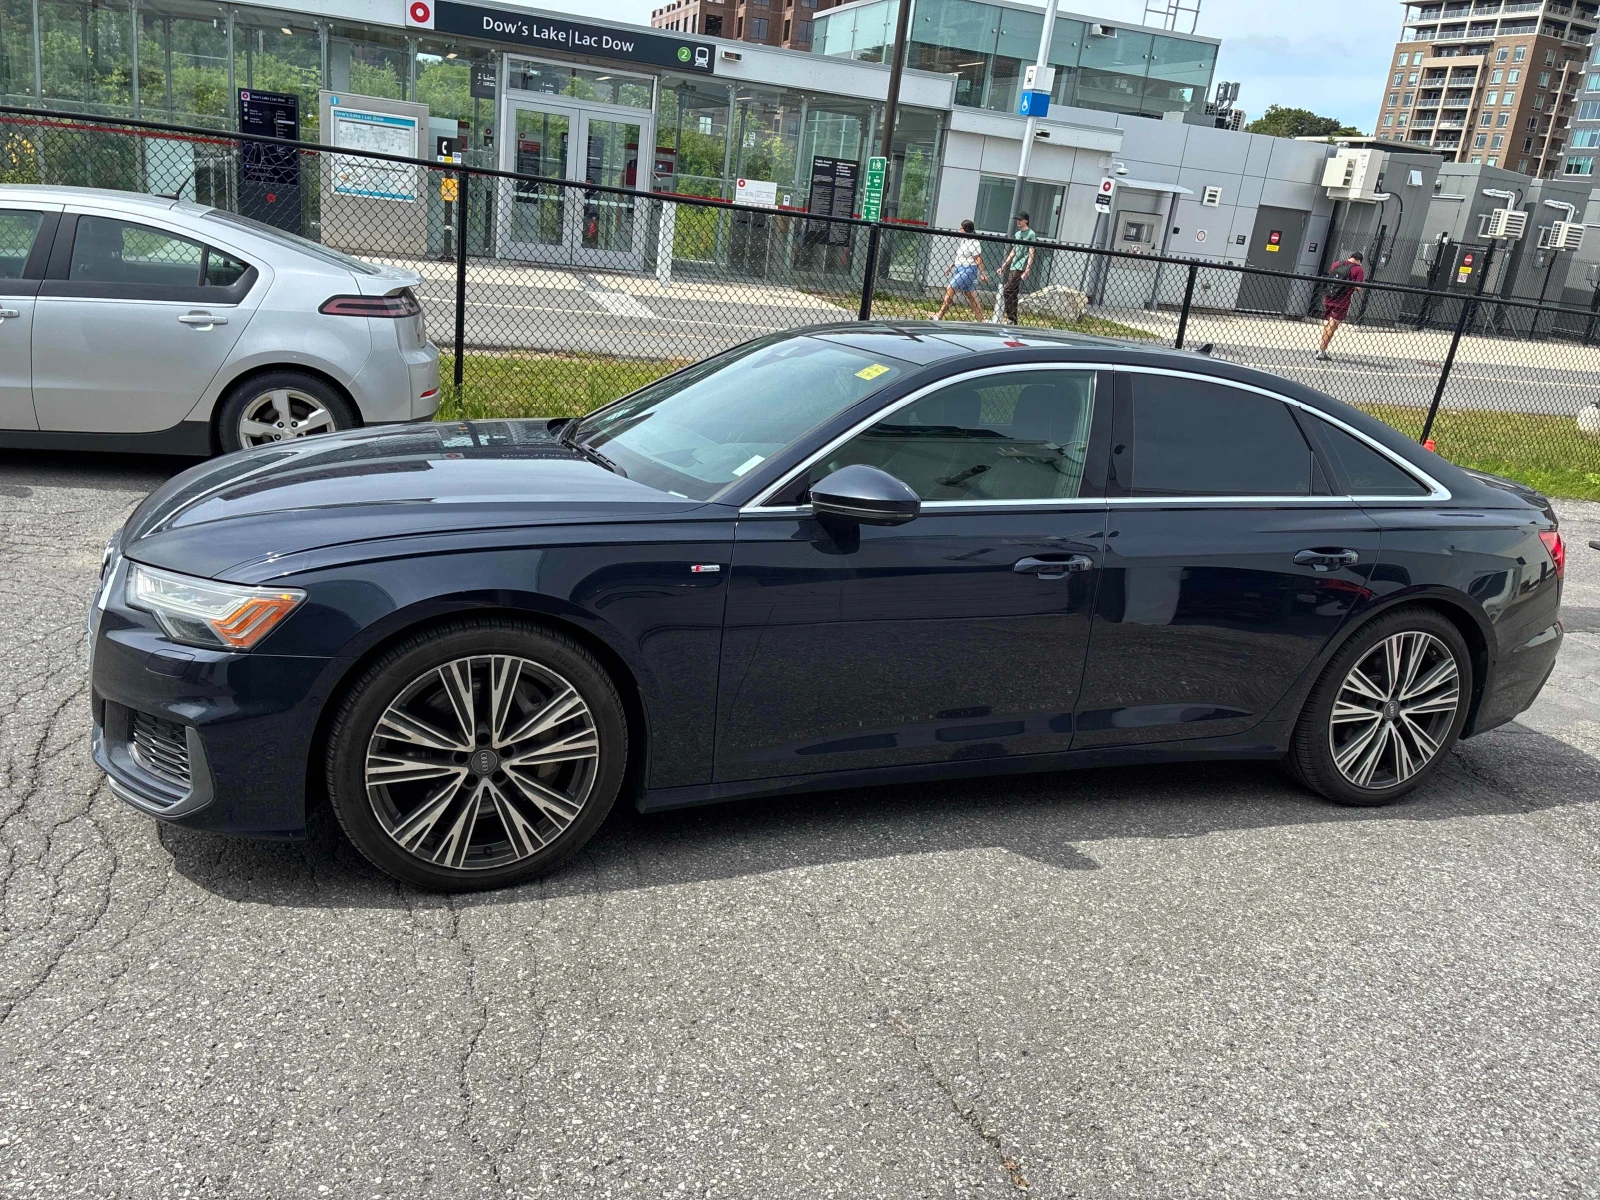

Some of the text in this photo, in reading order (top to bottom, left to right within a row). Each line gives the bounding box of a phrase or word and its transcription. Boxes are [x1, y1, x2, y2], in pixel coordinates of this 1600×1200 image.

[483, 16, 635, 53] Dow's Lake Lac Dow
[680, 49, 688, 60] 2
